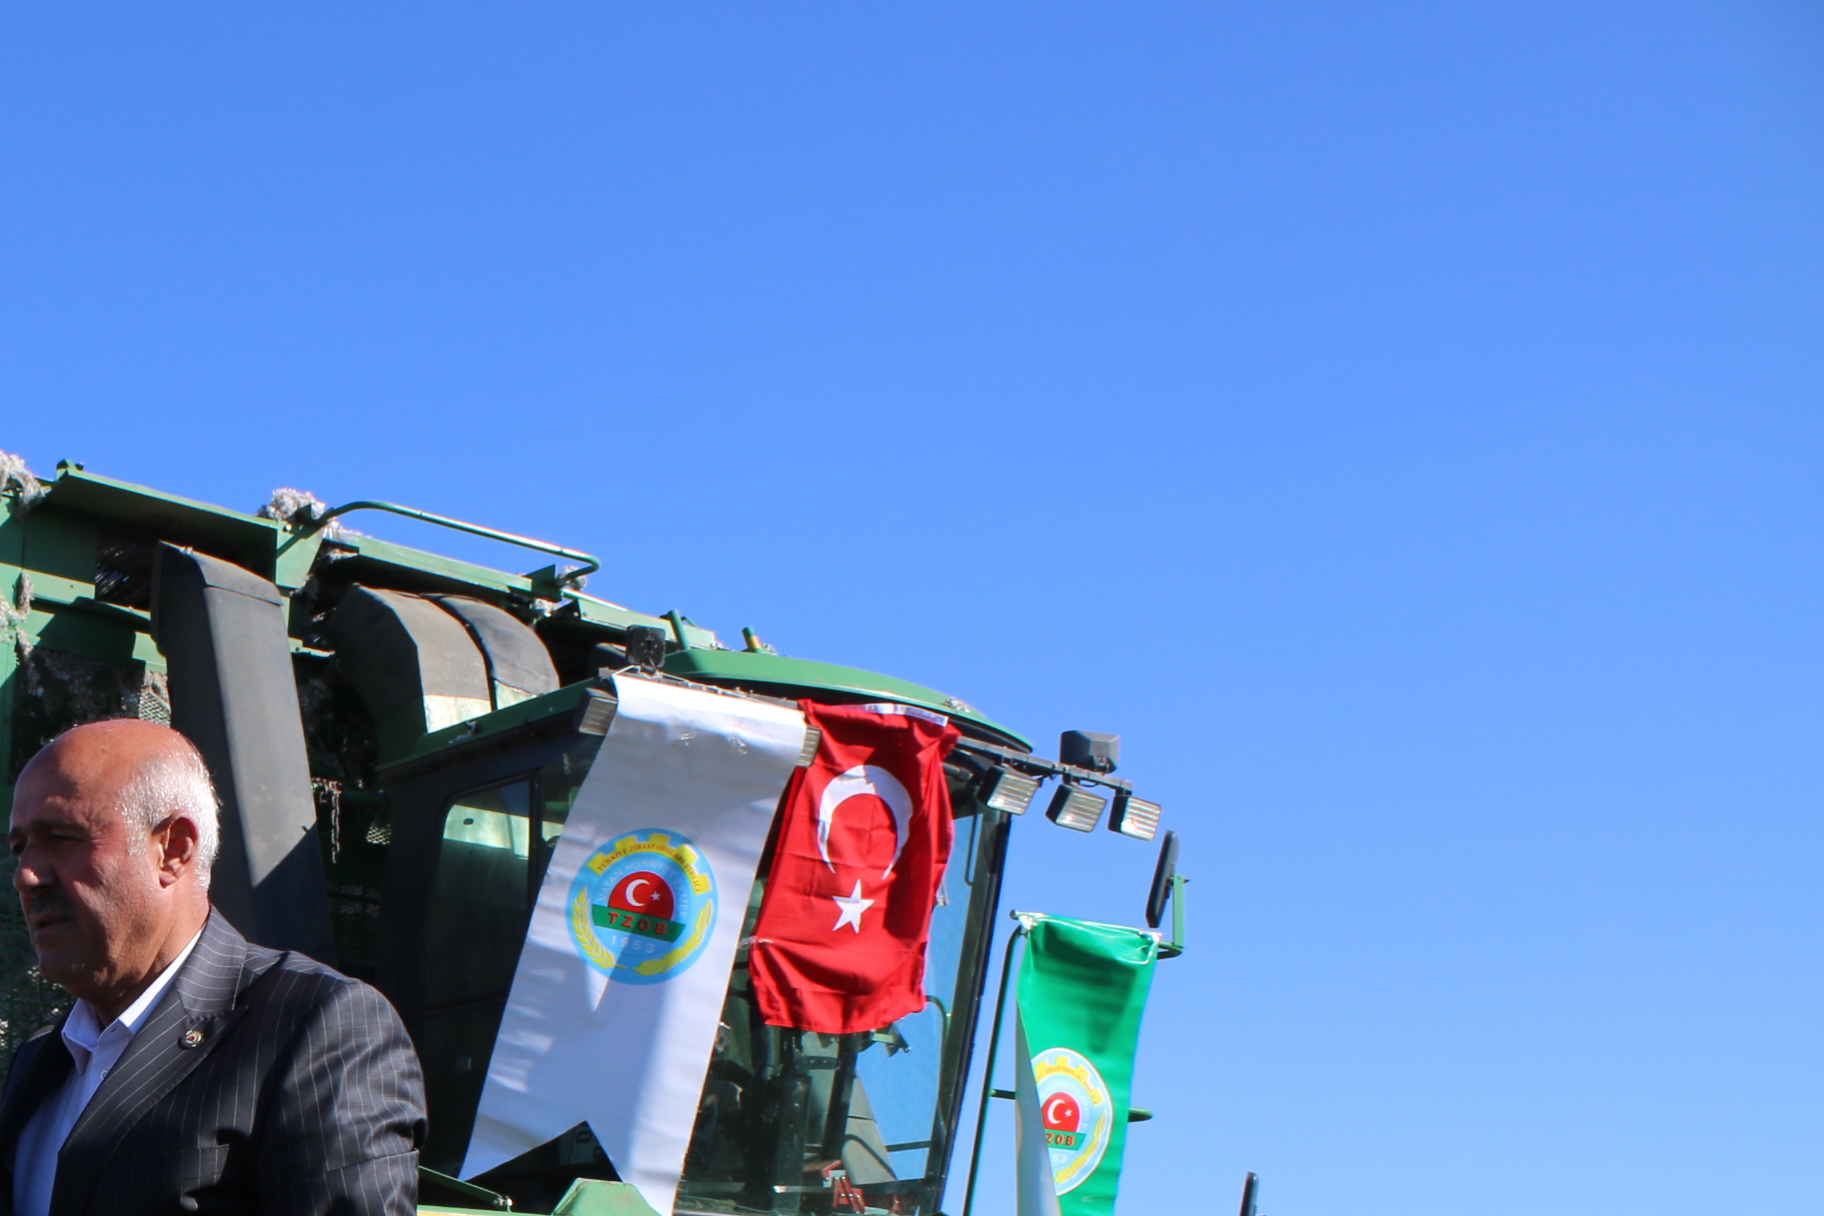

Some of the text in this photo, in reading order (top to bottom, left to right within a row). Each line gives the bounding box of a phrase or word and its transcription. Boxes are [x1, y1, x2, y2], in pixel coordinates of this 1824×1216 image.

[608, 911, 668, 935] TZOB
[611, 935, 655, 954] 1963
[1046, 1132, 1076, 1147] ZOB
[1052, 1153, 1067, 1164] 63
